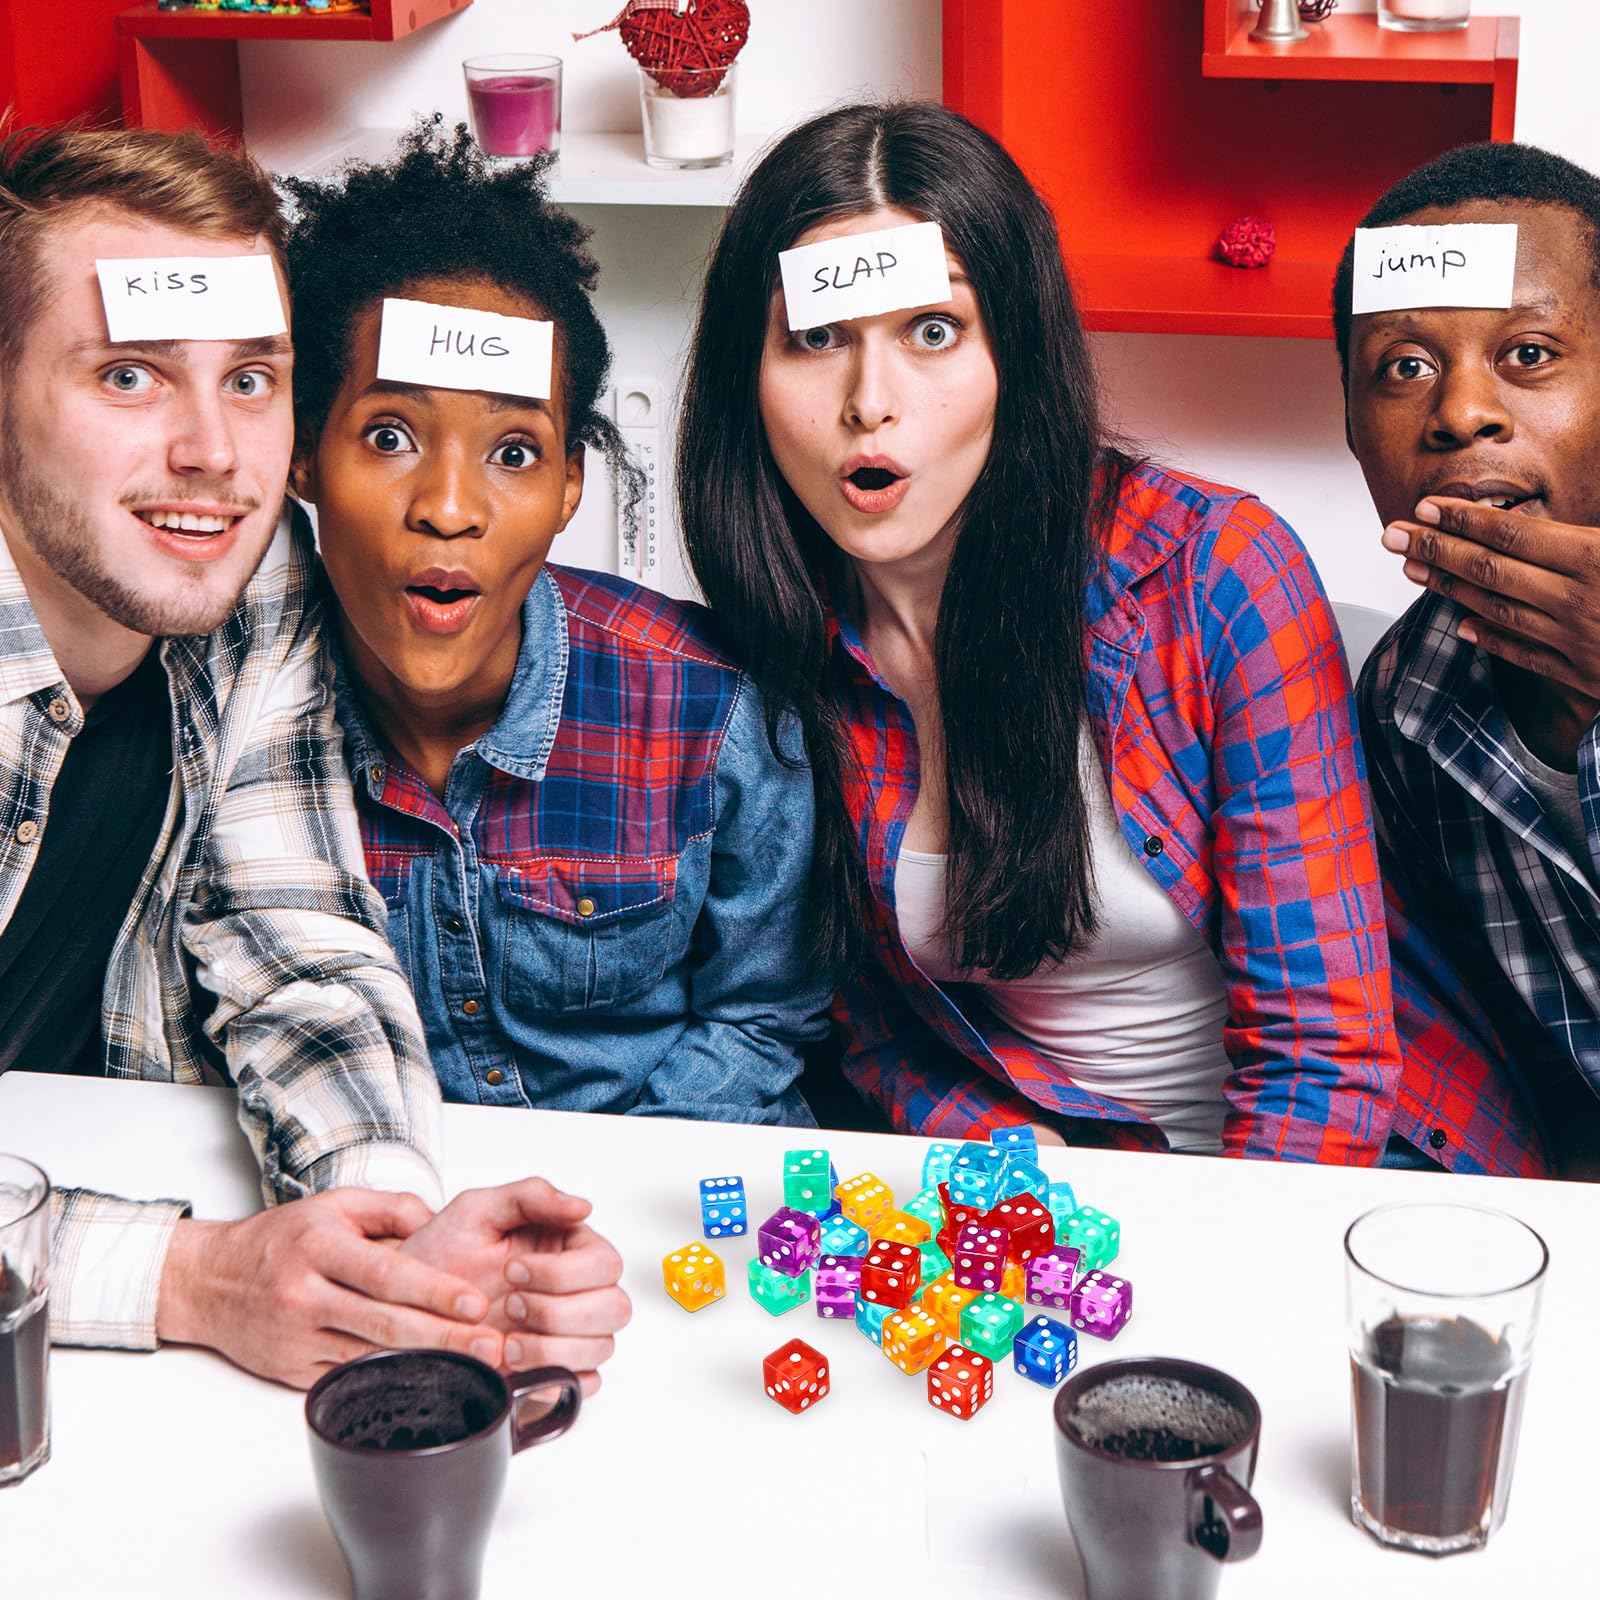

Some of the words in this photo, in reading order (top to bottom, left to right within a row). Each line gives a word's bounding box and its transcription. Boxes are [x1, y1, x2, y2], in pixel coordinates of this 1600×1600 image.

[811, 252, 898, 293] SLAP
[1371, 249, 1467, 279] jump
[429, 325, 511, 356] HUG
